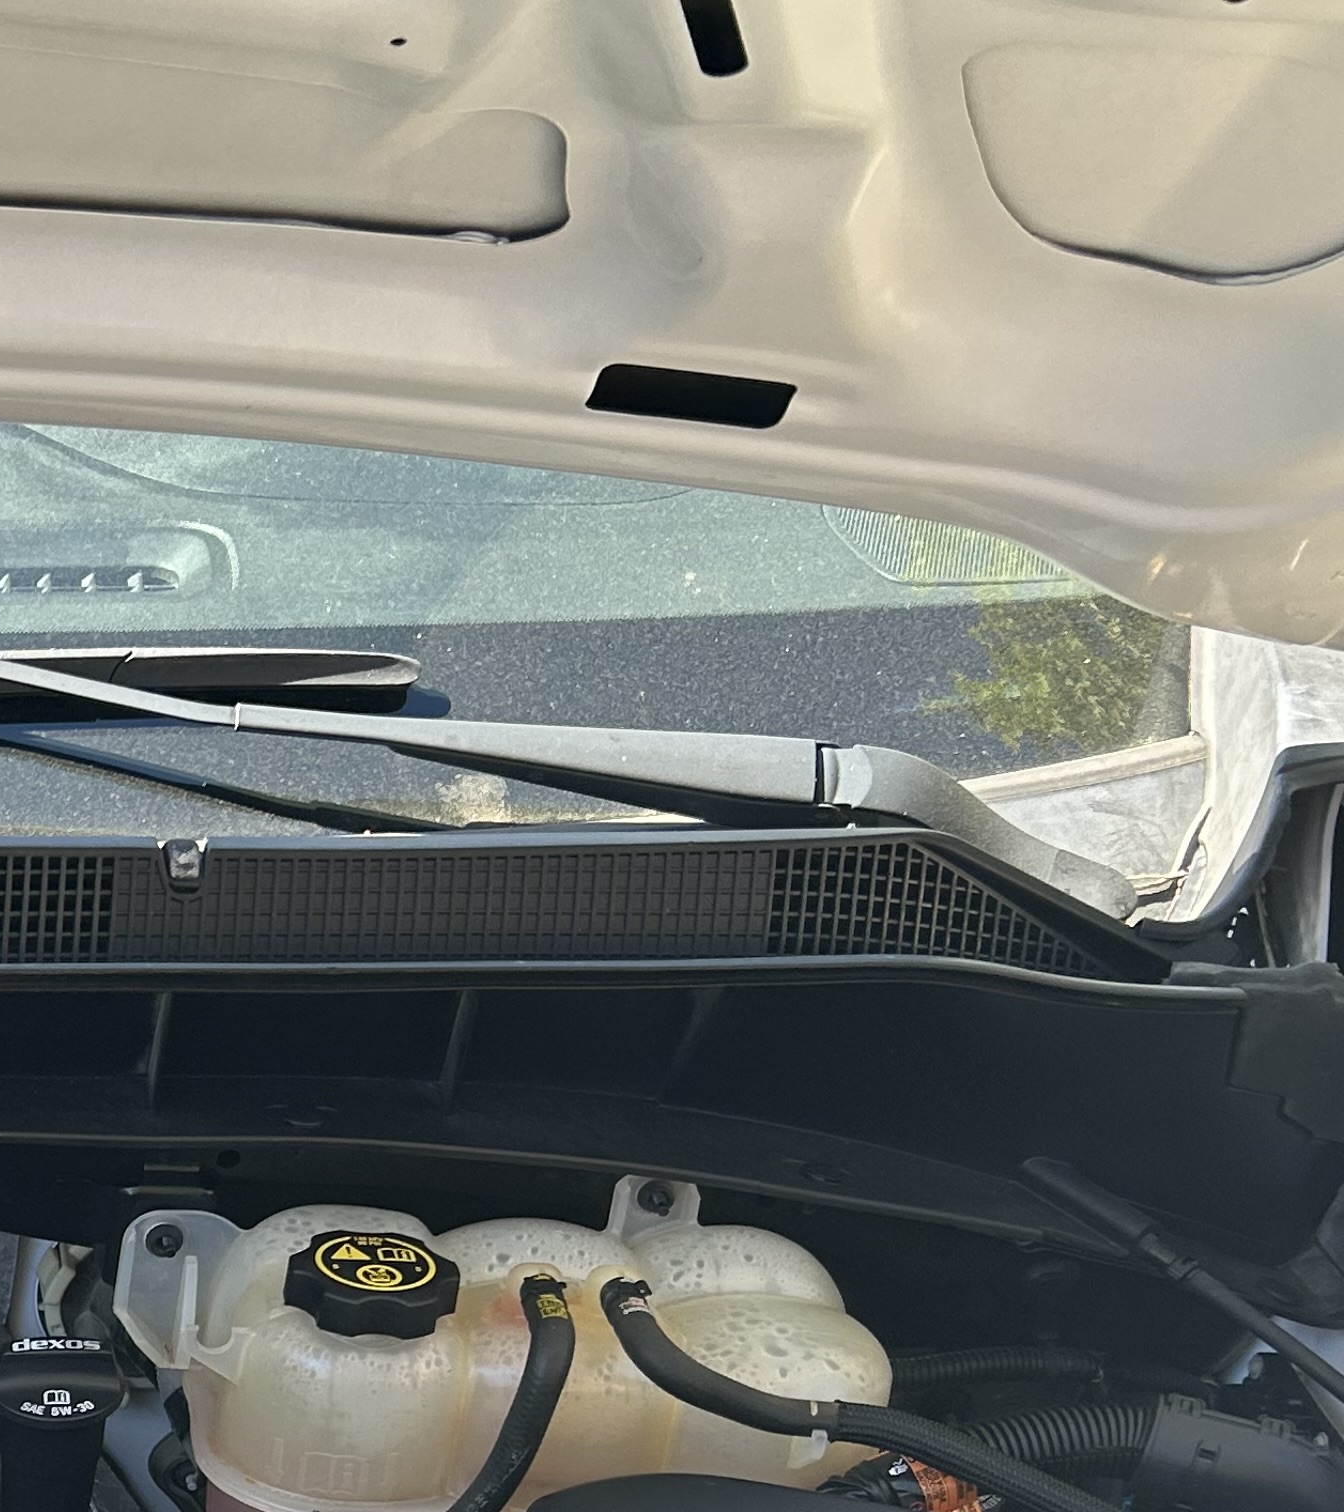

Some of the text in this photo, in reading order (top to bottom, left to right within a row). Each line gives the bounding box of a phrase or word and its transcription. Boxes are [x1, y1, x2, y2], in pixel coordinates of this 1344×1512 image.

[12, 1338, 100, 1352] dexos
[20, 1400, 95, 1416] SAE 5W-30
